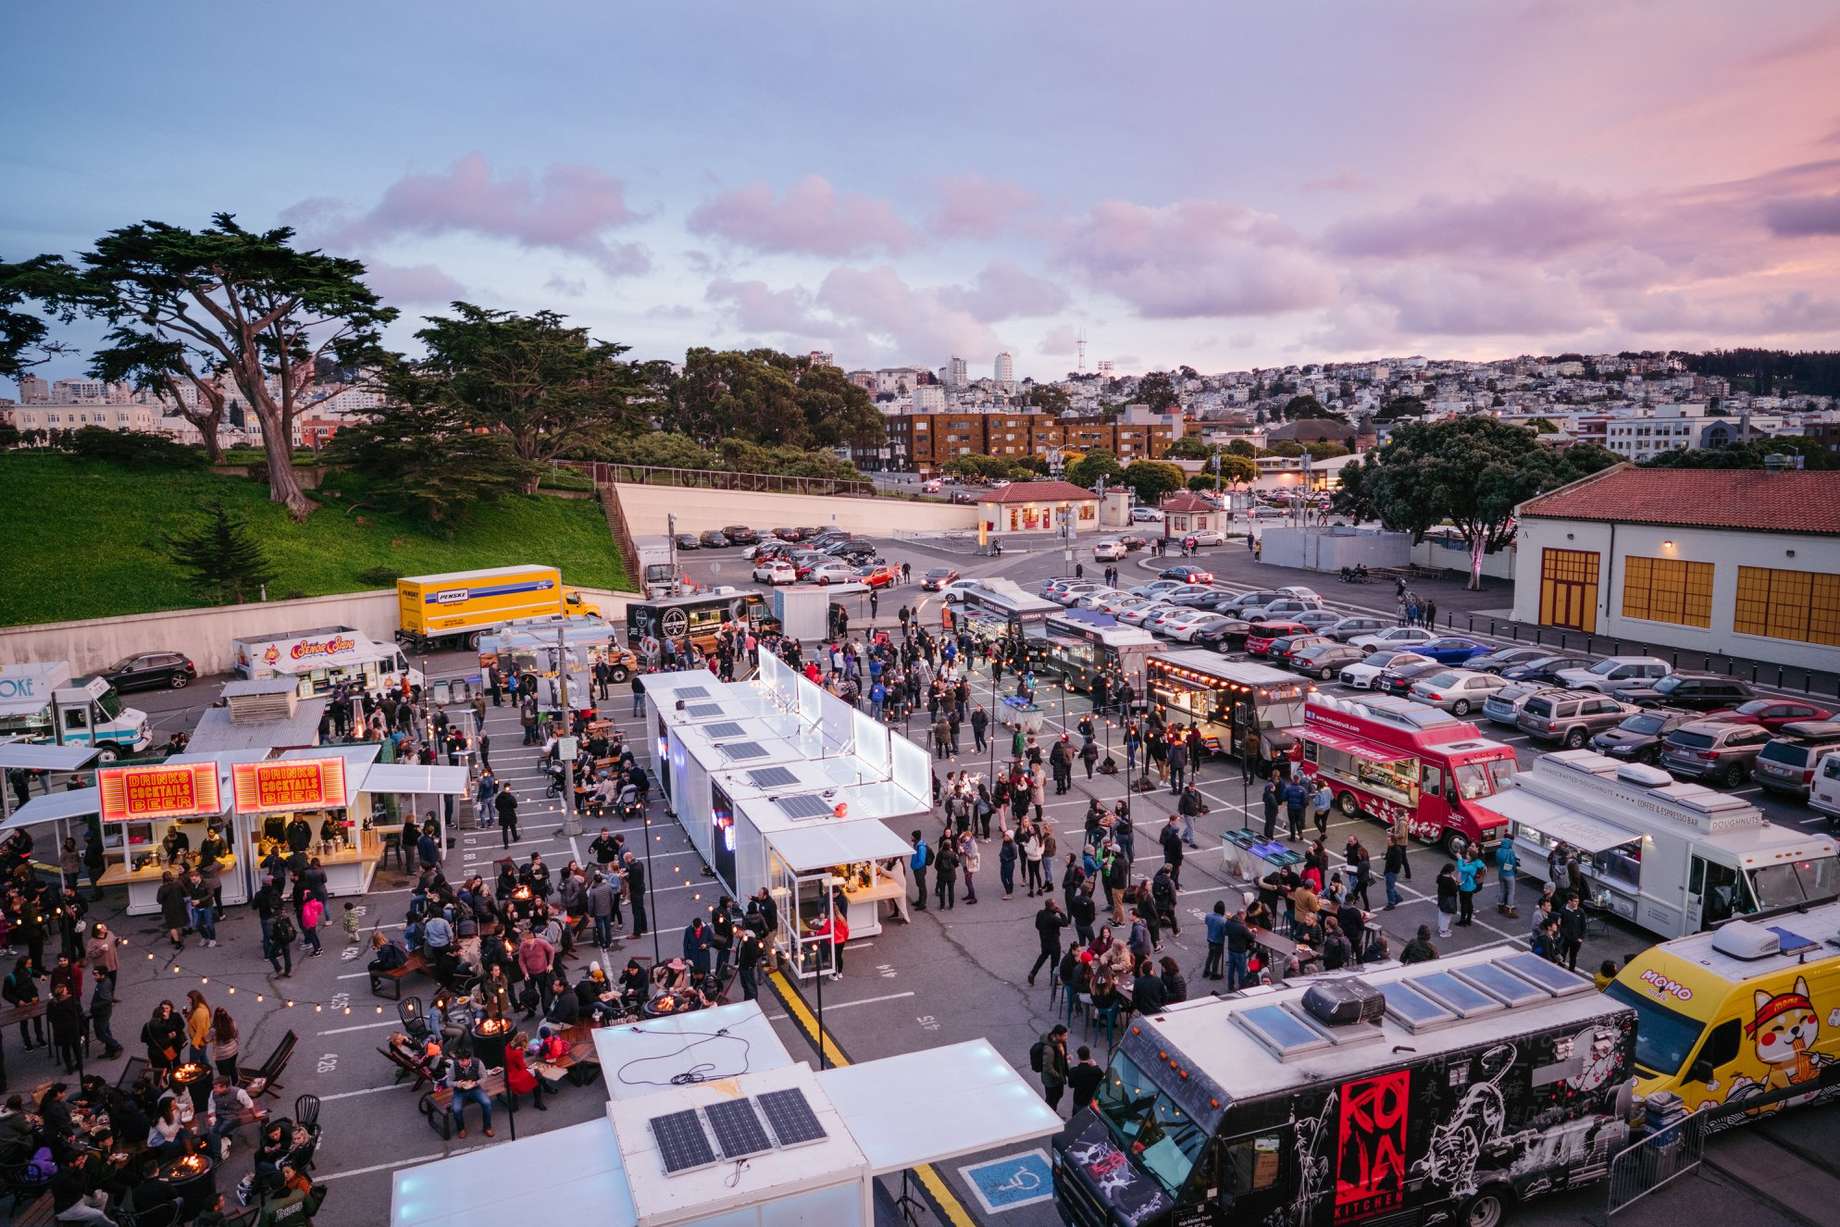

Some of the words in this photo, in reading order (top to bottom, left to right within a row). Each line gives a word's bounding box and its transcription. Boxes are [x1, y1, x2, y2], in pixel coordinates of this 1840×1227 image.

[440, 592, 468, 601] PENSKE
[128, 770, 188, 787] DRINKS
[260, 767, 317, 781] DRINKS
[130, 783, 190, 799] COCKTAILS
[261, 778, 318, 792] COCKTAILS
[131, 796, 192, 811] BEER
[262, 790, 320, 806] BEER
[1637, 799, 1654, 812] COFFEE
[1660, 807, 1686, 823] ESPRESSO
[1712, 815, 1759, 831] DOUGHNUTS
[341, 947, 359, 960] 424
[1640, 969, 1693, 1001] MOMO
[331, 992, 350, 1010] 425
[317, 1053, 339, 1073] 426
[1334, 1191, 1403, 1219] KITCHEN
